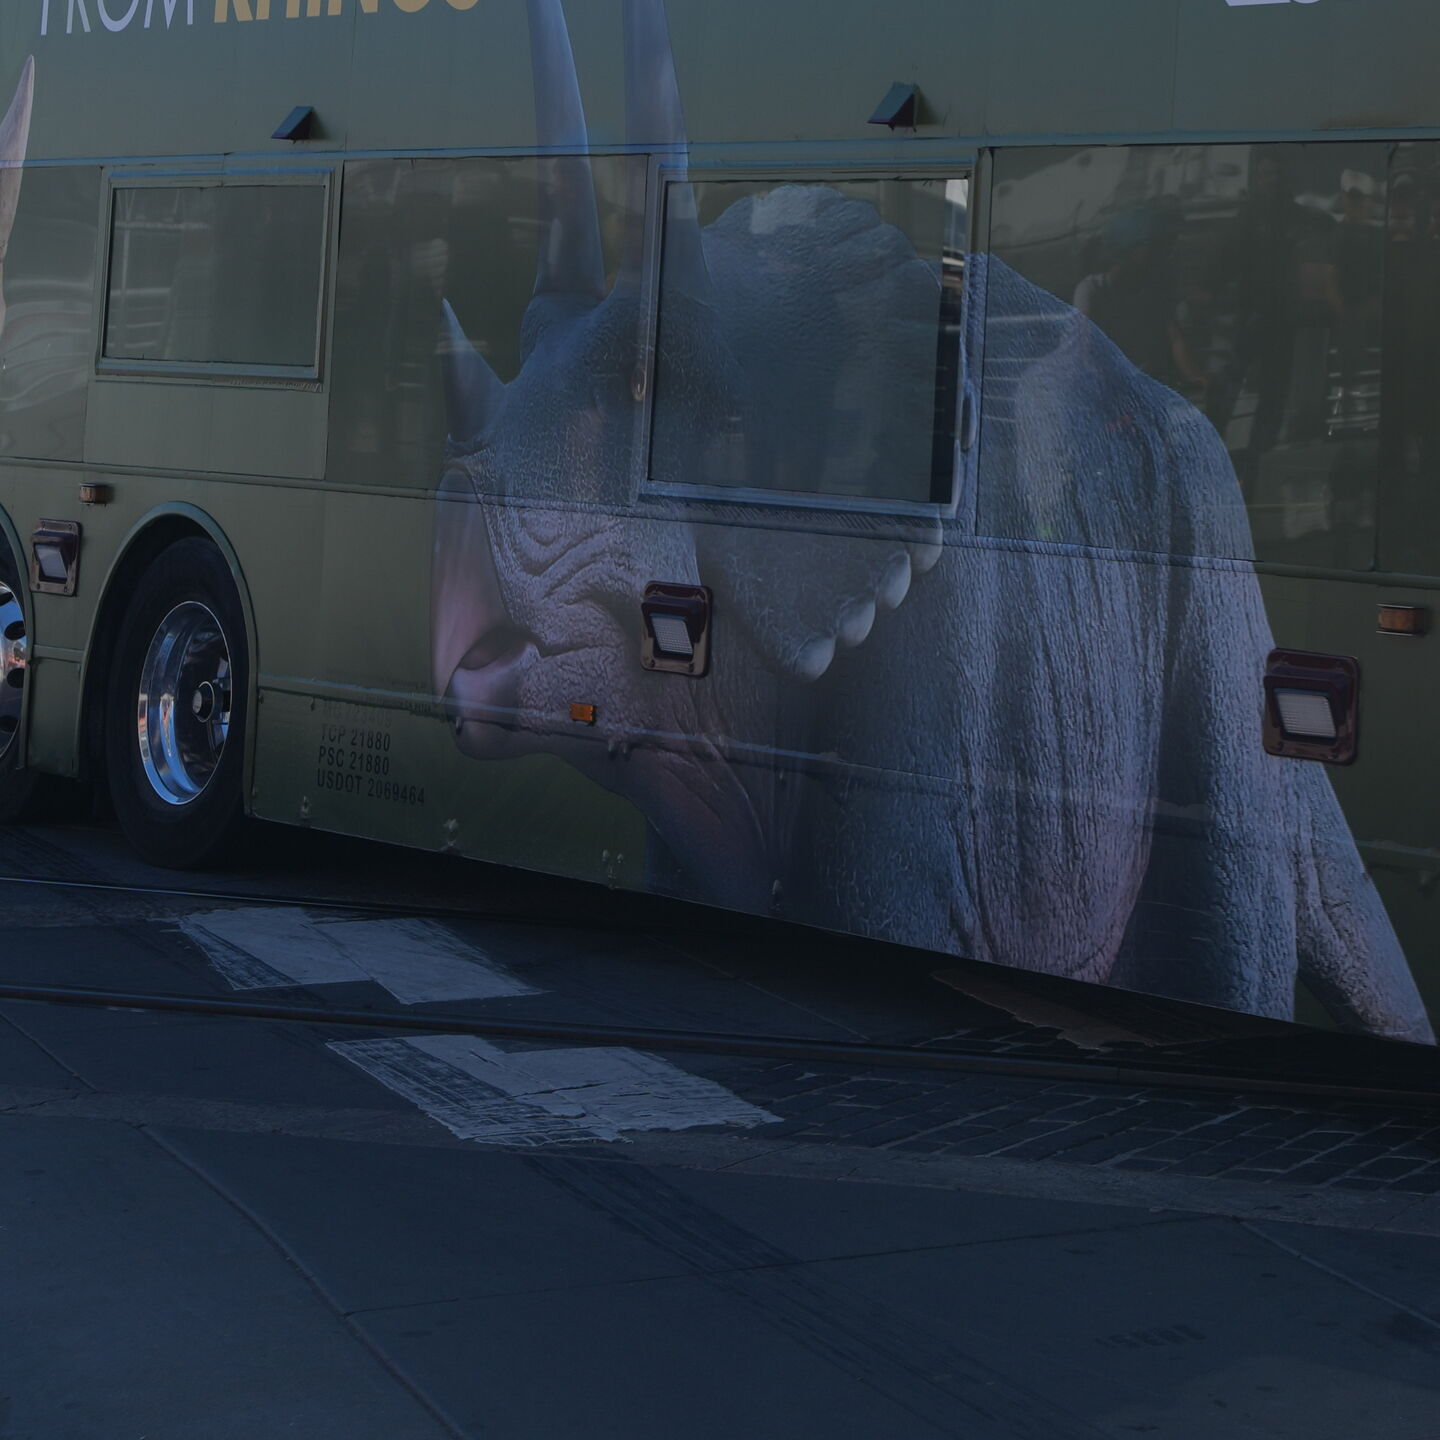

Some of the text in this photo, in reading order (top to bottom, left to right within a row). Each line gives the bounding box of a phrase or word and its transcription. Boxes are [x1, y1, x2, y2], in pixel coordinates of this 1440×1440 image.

[320, 723, 391, 752] TCP 21880
[318, 745, 390, 776] PSC 21880
[317, 767, 425, 805] USDOT 2069464
